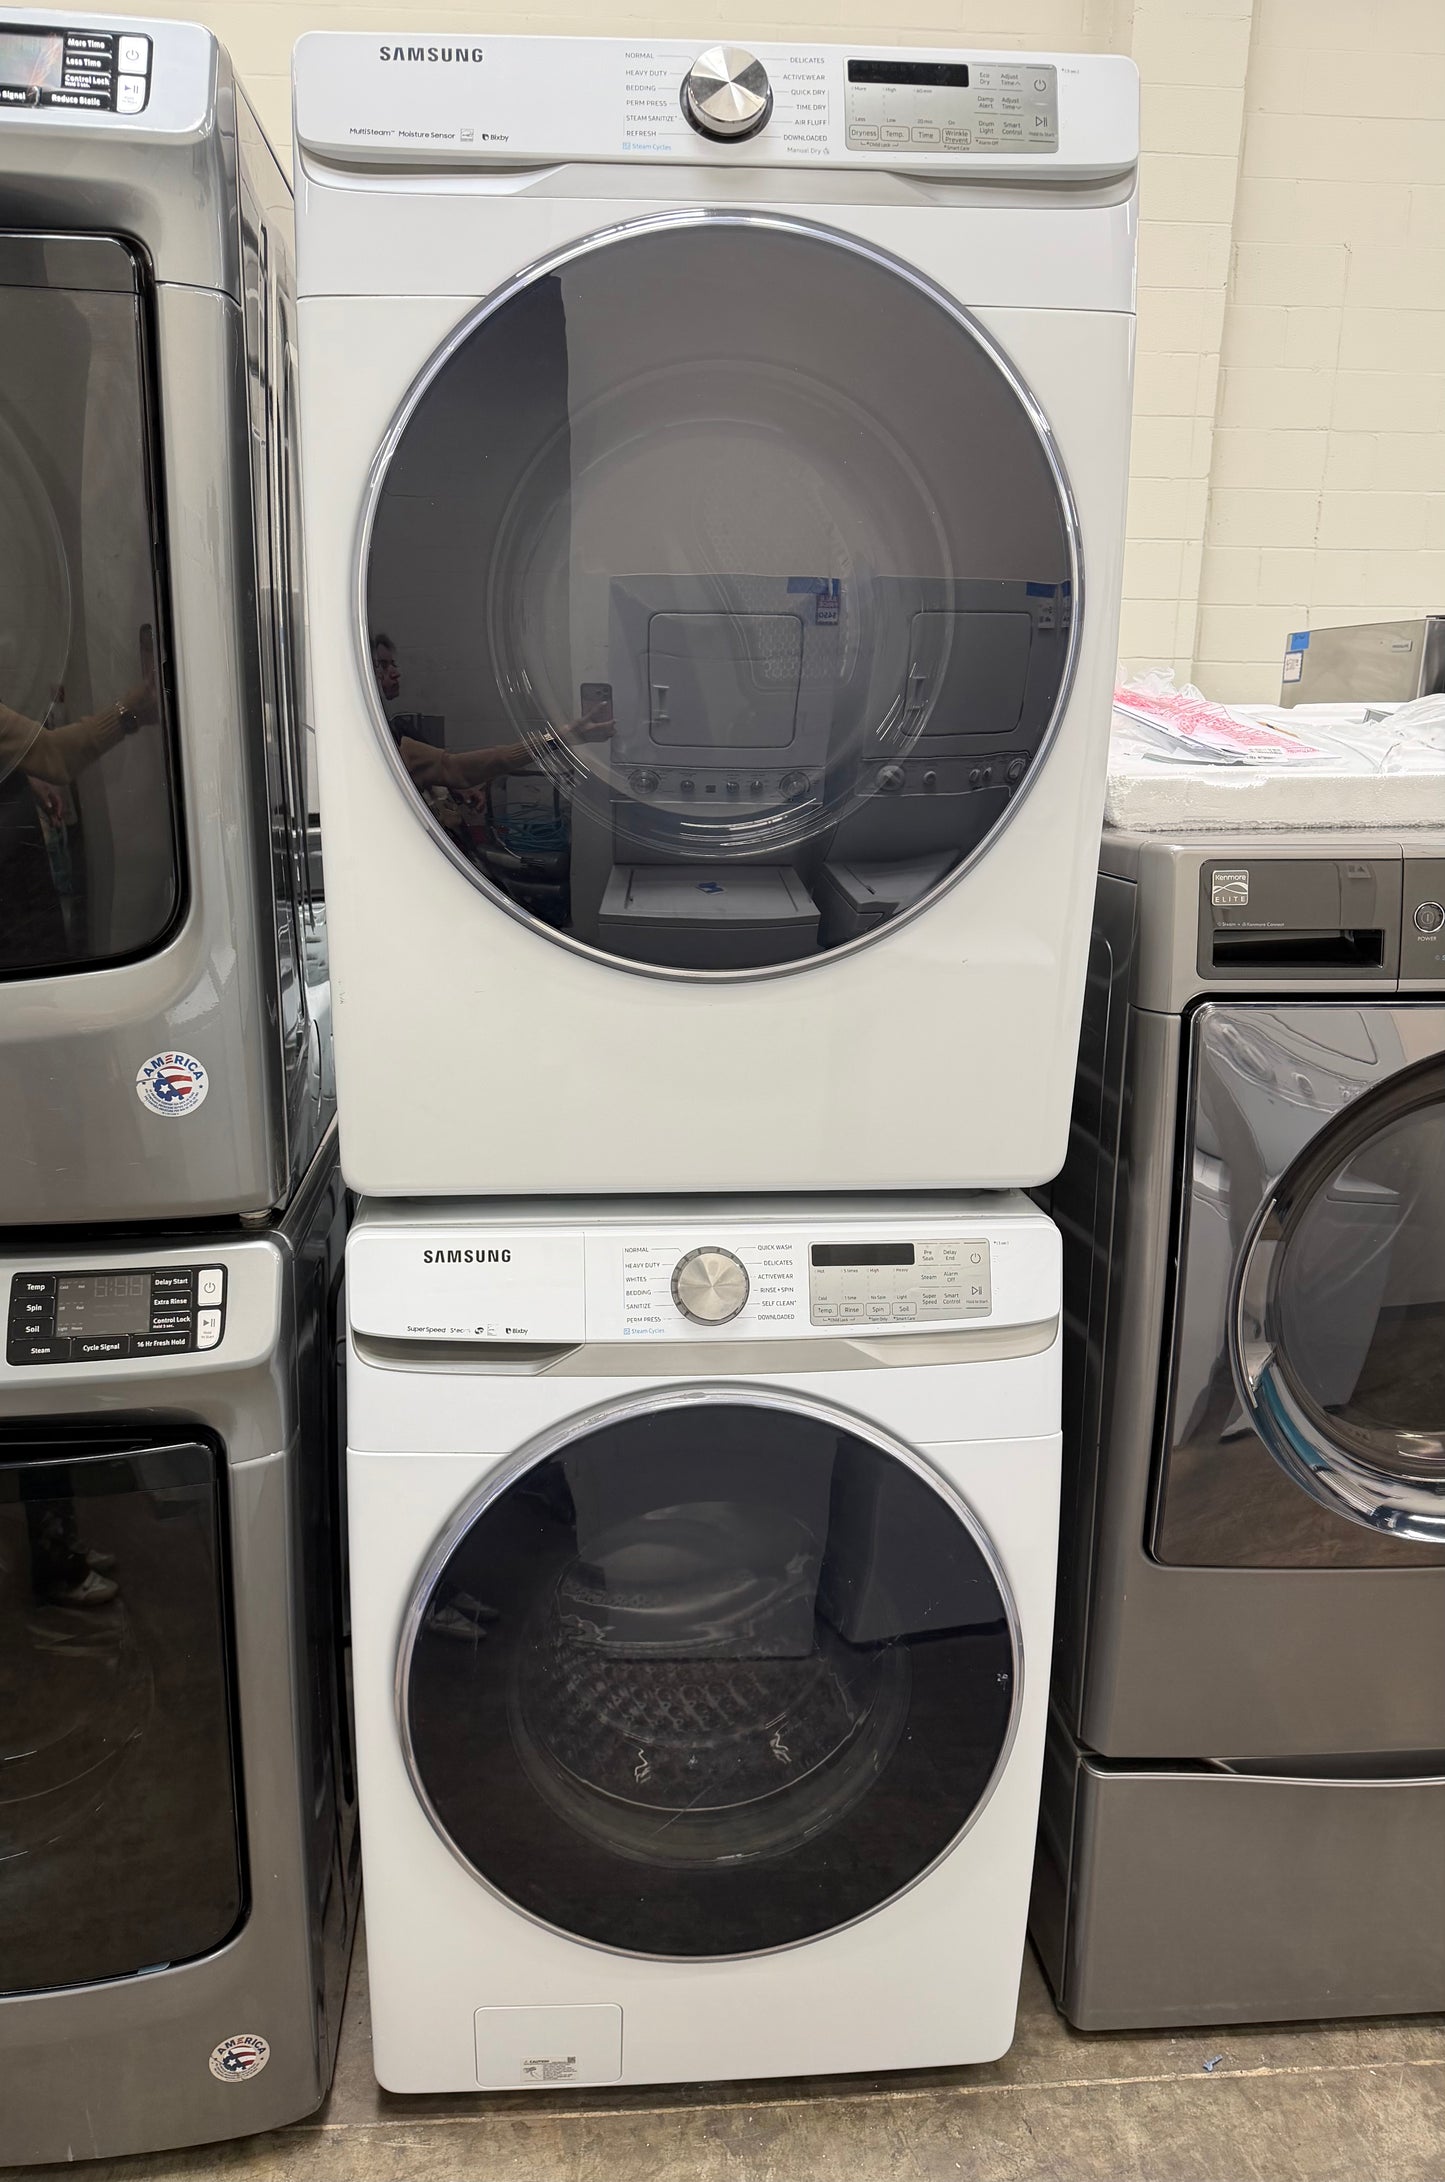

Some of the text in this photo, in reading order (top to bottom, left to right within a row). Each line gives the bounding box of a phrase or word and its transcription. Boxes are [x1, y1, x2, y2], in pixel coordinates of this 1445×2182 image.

[67, 38, 105, 49] More Time
[379, 45, 484, 63] SAMSUNG
[65, 57, 102, 67] Less Time
[64, 74, 110, 86] Control Lock
[2, 90, 26, 100] Signal
[51, 94, 101, 106] Reduce Static
[399, 130, 430, 138] Moisture
[490, 134, 509, 143] Bixby
[652, 144, 672, 152] Cycles
[810, 147, 822, 155] Dry
[143, 1054, 204, 1080] AMERICA
[423, 1248, 512, 1264] SAMSUNG
[27, 1283, 45, 1291] Temp
[26, 1304, 42, 1312] Spin
[153, 1316, 175, 1324] Control
[25, 1325, 40, 1333] Soil
[512, 1327, 528, 1335] Bixby
[171, 1338, 186, 1346] Hold
[83, 1342, 120, 1352] Cycle Signal
[217, 2036, 266, 2055] AMERICA
